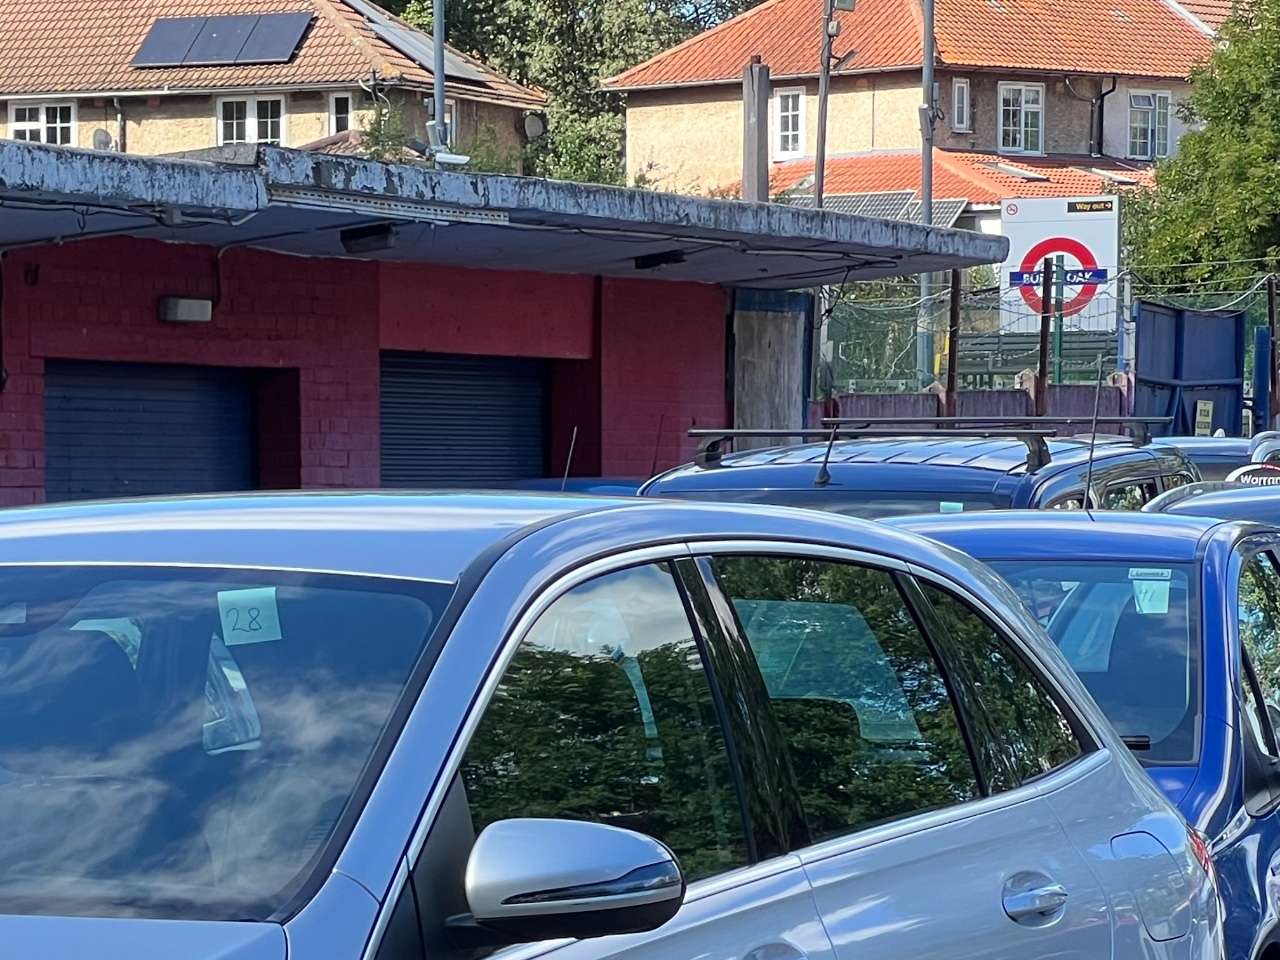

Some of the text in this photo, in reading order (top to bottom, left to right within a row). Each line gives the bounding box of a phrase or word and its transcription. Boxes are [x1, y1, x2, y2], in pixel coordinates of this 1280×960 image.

[1075, 202, 1105, 211] Way out
[1066, 272, 1093, 283] OAK
[225, 607, 263, 633] 28
